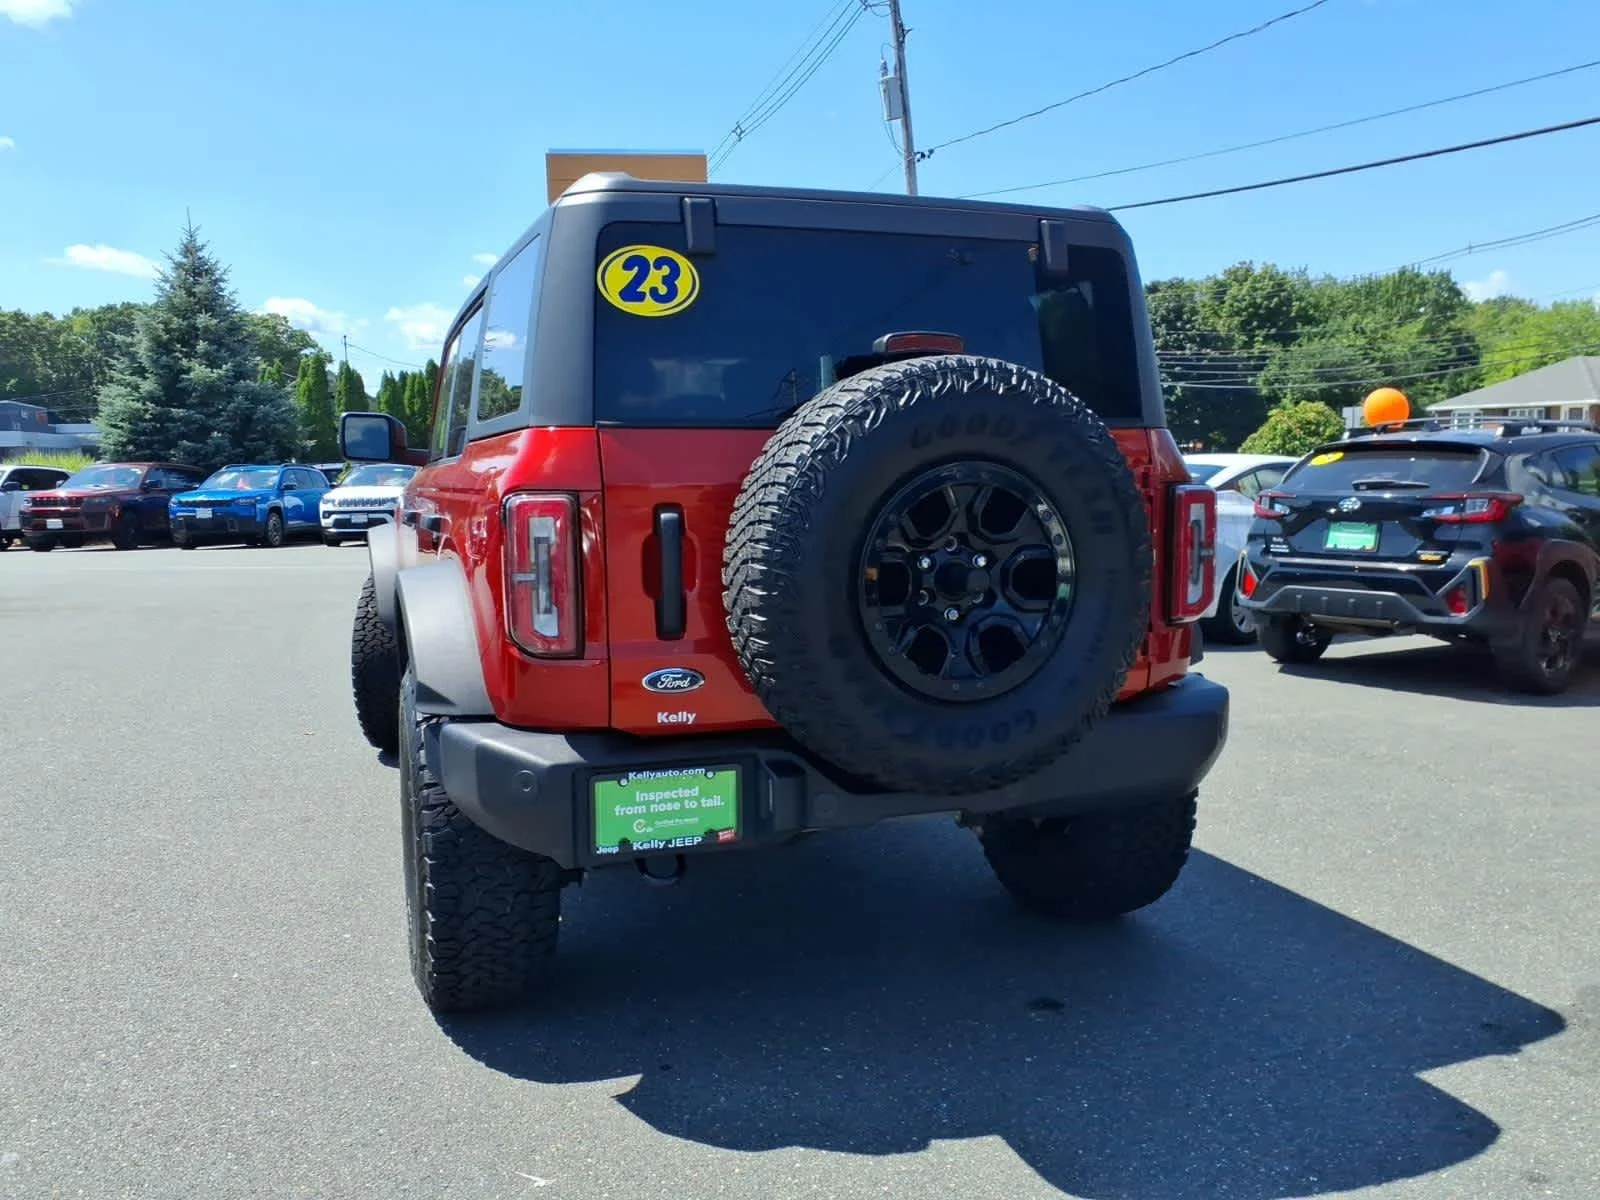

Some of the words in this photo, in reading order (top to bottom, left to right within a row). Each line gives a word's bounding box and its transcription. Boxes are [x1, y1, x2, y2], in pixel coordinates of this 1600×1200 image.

[619, 255, 681, 304] 23
[657, 674, 691, 688] Ford
[657, 711, 696, 725] Kelly
[628, 768, 705, 780] Kellyauto.com
[636, 786, 699, 802] Inspected
[614, 804, 646, 816] from
[650, 802, 681, 813] nose
[684, 799, 698, 808] to
[701, 795, 724, 807] tail.
[596, 846, 619, 854] Jeep
[632, 839, 665, 851] Kelly
[668, 836, 702, 848] JEEP
